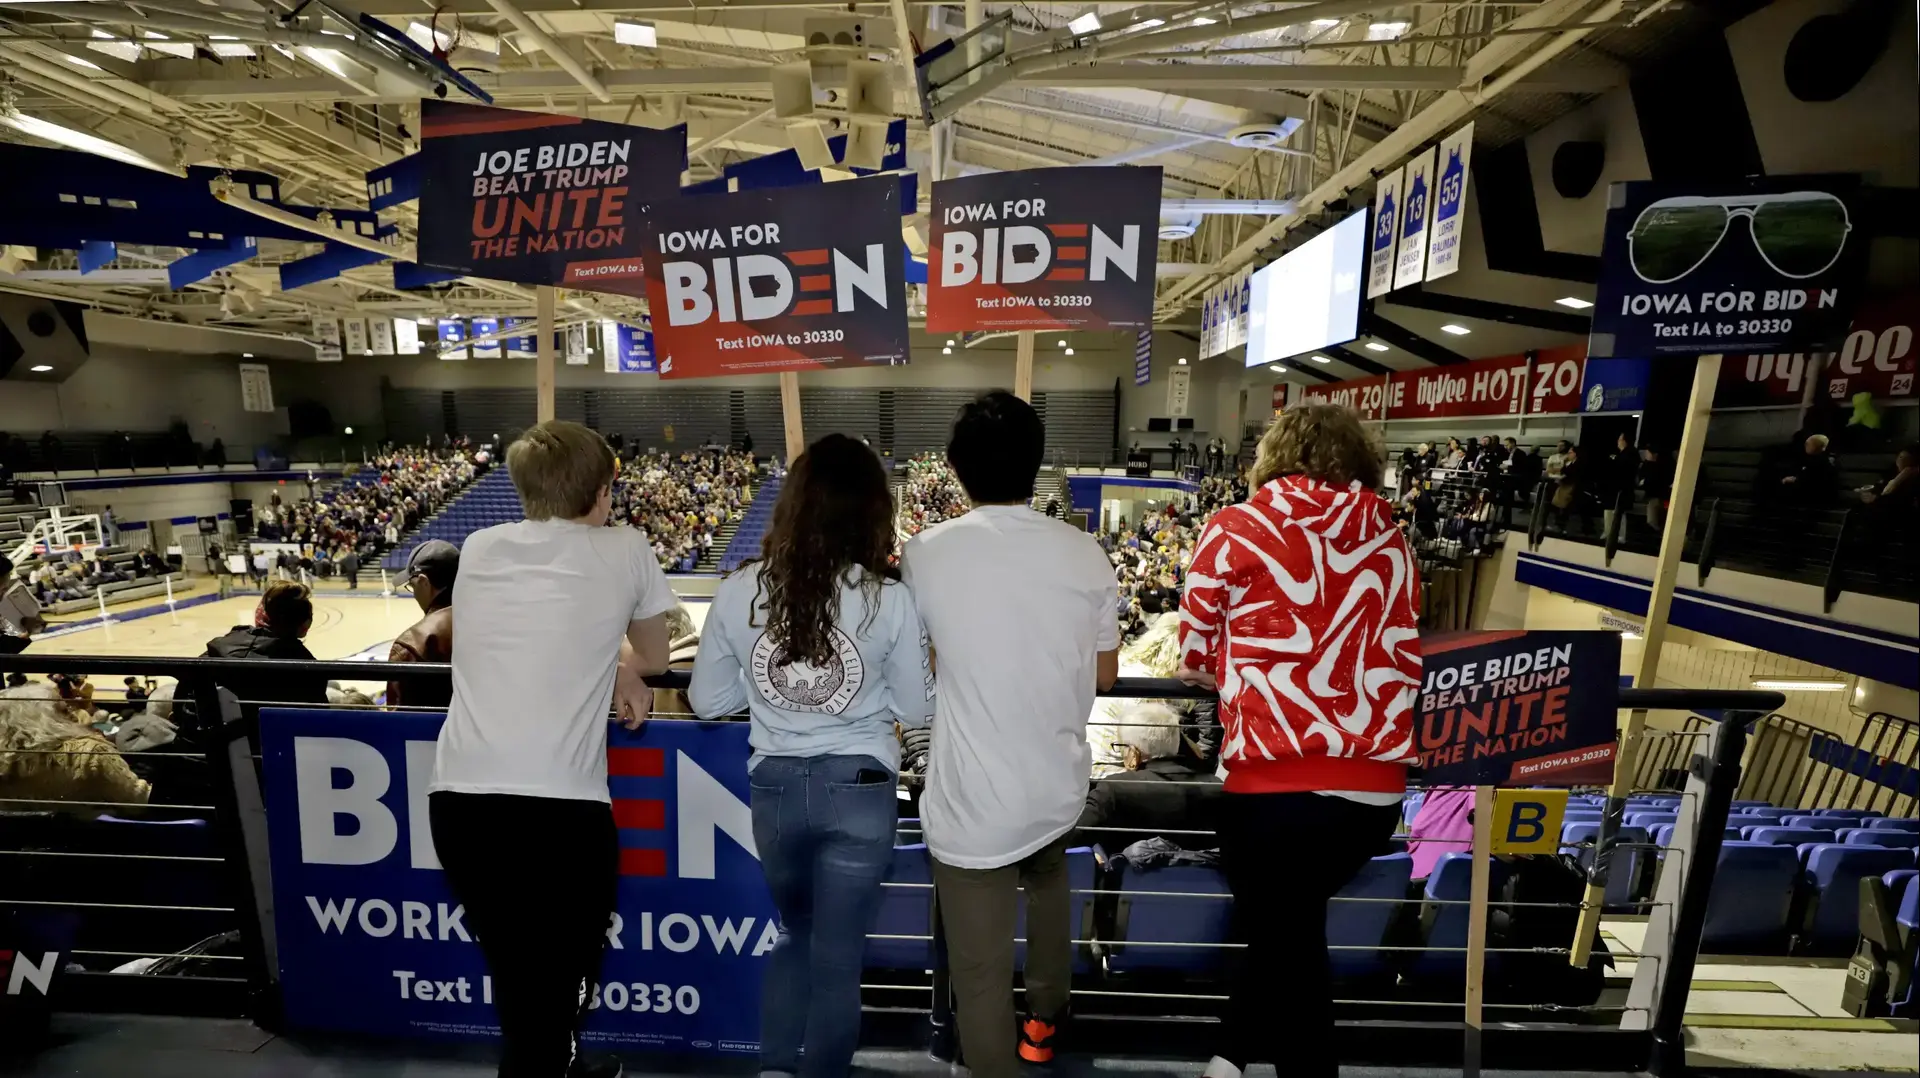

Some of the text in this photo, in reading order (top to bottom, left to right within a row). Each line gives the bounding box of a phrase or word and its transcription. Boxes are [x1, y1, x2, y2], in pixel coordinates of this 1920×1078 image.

[472, 140, 631, 176] JOE BIDEN
[472, 164, 628, 196] BEAT TRUMP
[1442, 172, 1460, 206] 55
[472, 186, 629, 238] UNITE
[944, 198, 1046, 226] IOWA FOR
[1378, 210, 1392, 238] 33
[1409, 194, 1422, 222] 13
[470, 227, 626, 260] THE NATION
[658, 222, 780, 254] IOWA FOR
[574, 268, 594, 277] Text
[596, 266, 625, 274] IOWA
[628, 264, 638, 272] to
[941, 223, 1141, 288] BIDEN
[662, 243, 888, 327] BIDEN
[976, 295, 1092, 308] Text IOWA to 30330
[1622, 288, 1838, 315] IOWA FOR BIDEN
[716, 329, 844, 350] Text IOWA to 30330
[1653, 319, 1792, 337] Text IA to 30330
[1472, 365, 1526, 402] HOT
[1533, 358, 1587, 398] ZO
[1831, 383, 1845, 393] 23
[1893, 379, 1910, 390] 24
[1128, 461, 1147, 469] HURD
[1602, 616, 1640, 633] RESTROOMS
[754, 644, 770, 683] IVORY
[845, 657, 857, 685] ELLA
[1422, 643, 1573, 694] JOE BIDEN
[1422, 666, 1571, 713] BEAT TRUMP
[1421, 685, 1571, 749] UNITE
[1420, 722, 1568, 770] THE NATION
[1520, 749, 1610, 774] Text IOWA to 30330
[294, 736, 764, 879] BIEN
[1506, 802, 1547, 843] B
[305, 896, 482, 943] WORK
[641, 912, 780, 956] IOWA
[392, 970, 472, 1004] Text
[1853, 967, 1865, 980] 13
